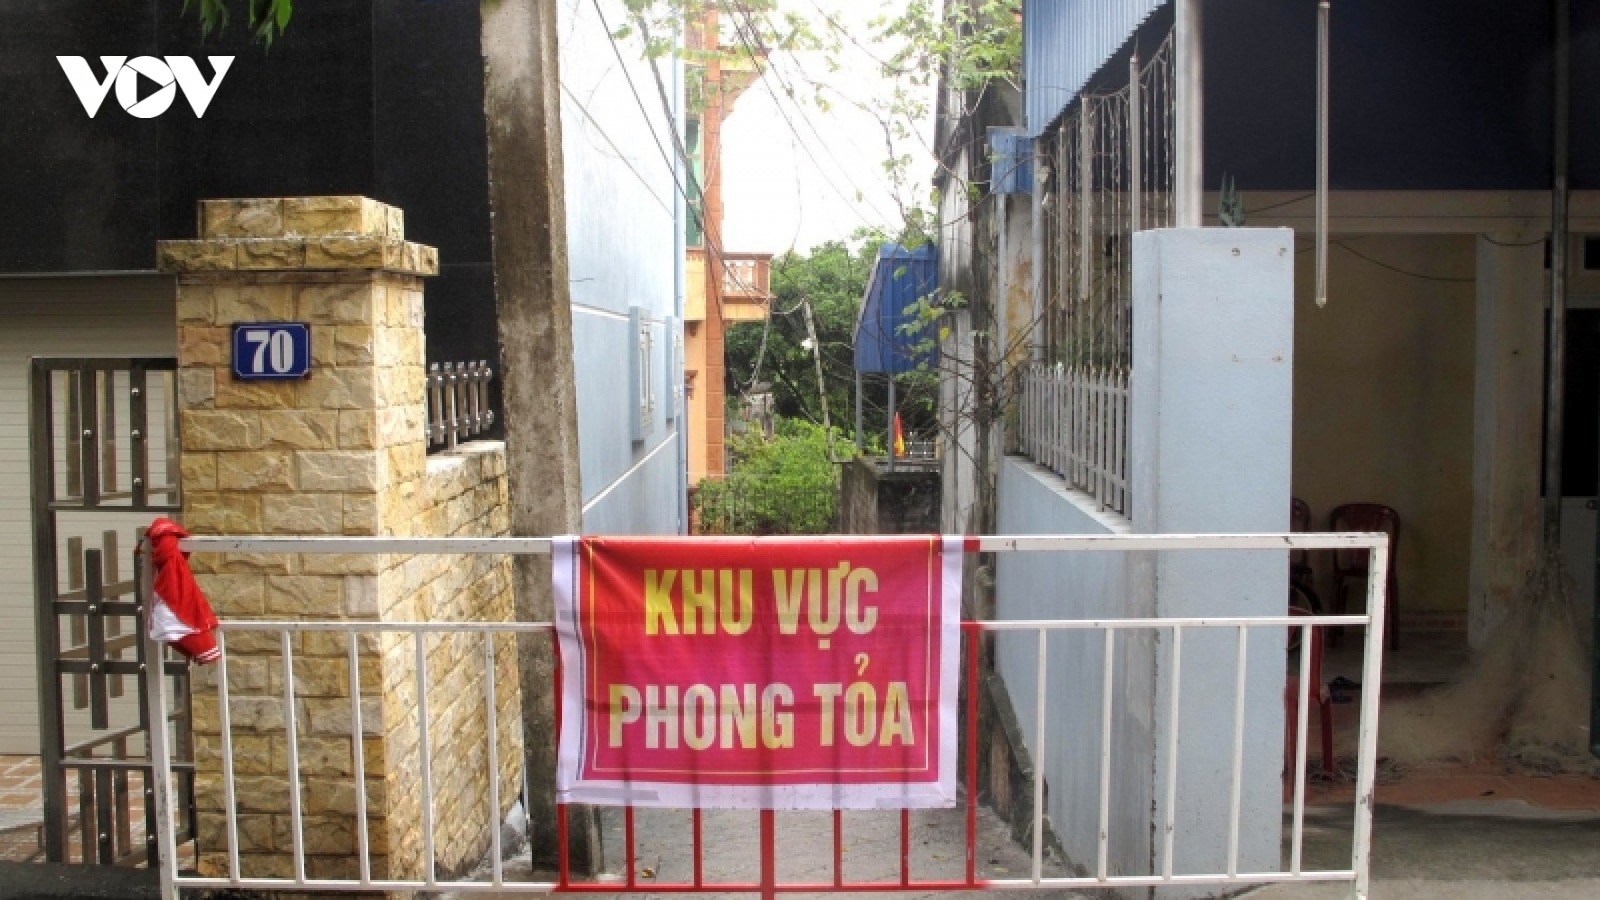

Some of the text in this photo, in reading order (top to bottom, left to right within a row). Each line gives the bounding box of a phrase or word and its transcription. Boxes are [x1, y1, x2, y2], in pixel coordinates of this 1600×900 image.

[246, 329, 294, 373] 70
[644, 561, 879, 650] KHU VỰC
[608, 653, 915, 750] PHONG TỎA
